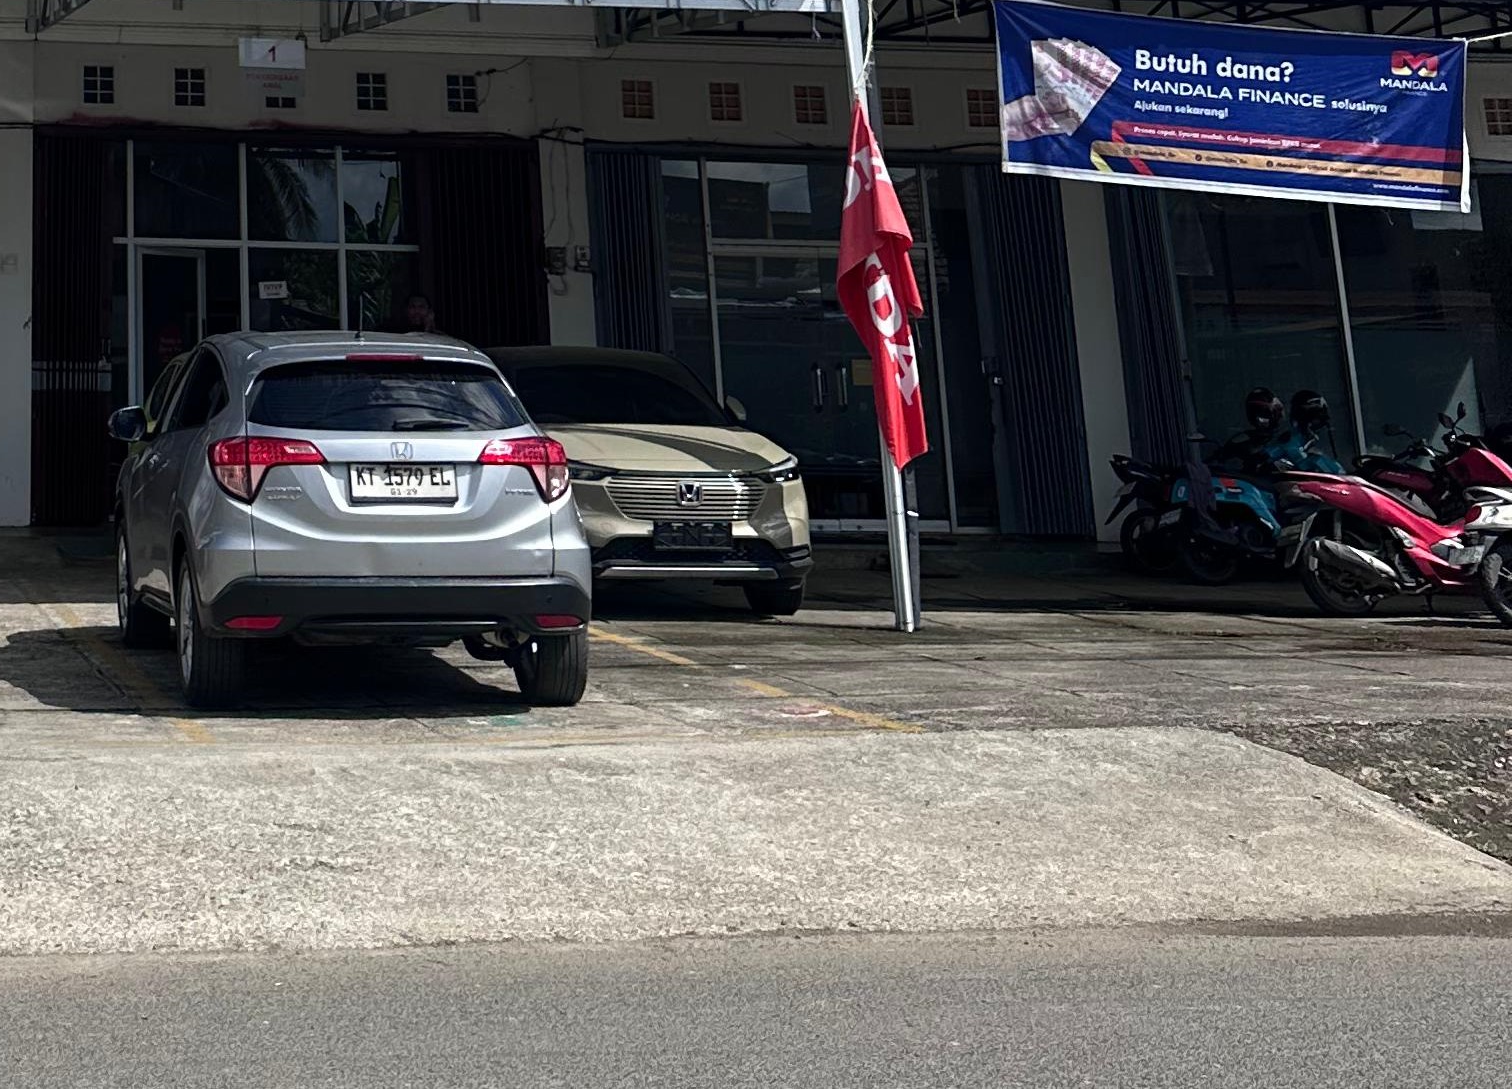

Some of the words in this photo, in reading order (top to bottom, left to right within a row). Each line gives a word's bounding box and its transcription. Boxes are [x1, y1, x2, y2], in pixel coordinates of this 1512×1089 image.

[268, 45, 276, 62] 1
[1134, 49, 1208, 76] Butuh
[1216, 56, 1294, 83] dana?
[1380, 77, 1448, 92] MANDALA
[1133, 78, 1233, 100] MANDALA
[1238, 88, 1326, 108] FINANCE
[1331, 99, 1388, 115] solusinya
[1134, 100, 1172, 113] Ajukan
[355, 466, 375, 486] KT
[384, 465, 425, 486] 1579
[429, 466, 451, 486] EL
